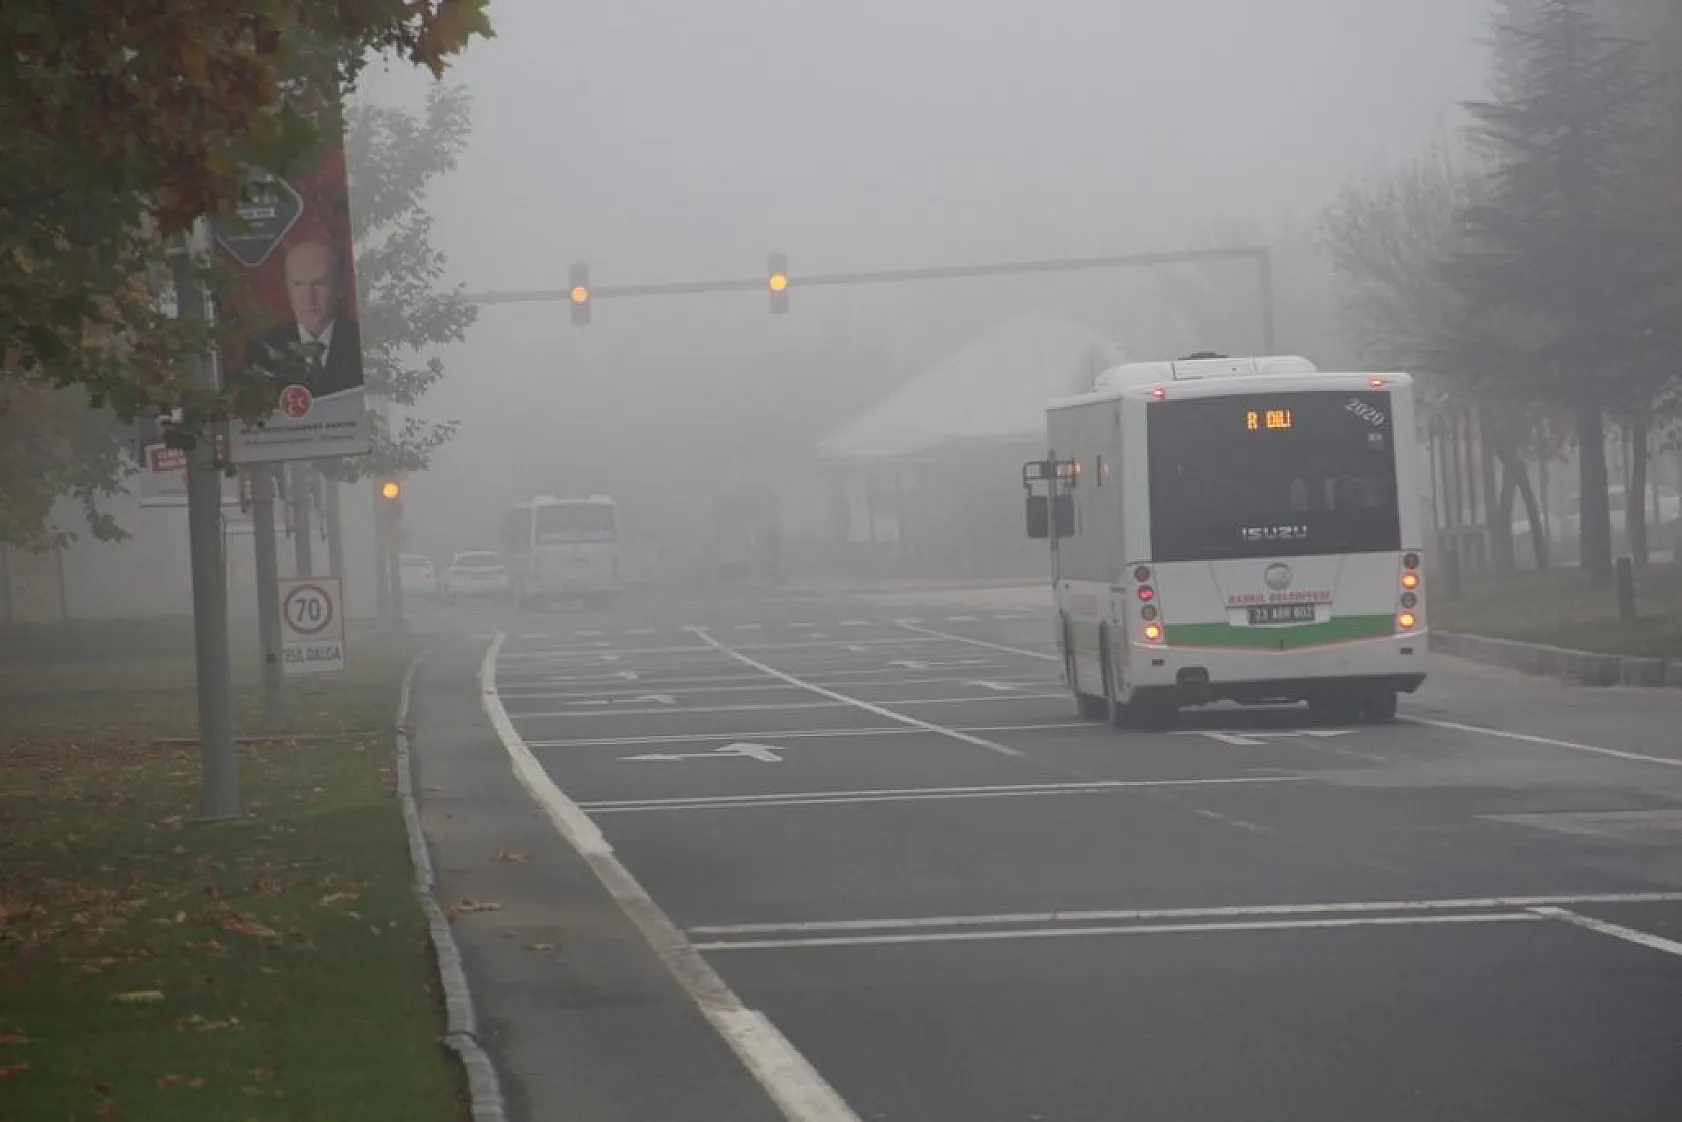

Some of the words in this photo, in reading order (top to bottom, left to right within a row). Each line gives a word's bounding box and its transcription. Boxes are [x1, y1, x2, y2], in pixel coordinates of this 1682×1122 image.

[1345, 398, 1385, 426] 2020
[1242, 524, 1308, 541] ISUZU
[295, 599, 321, 622] 70
